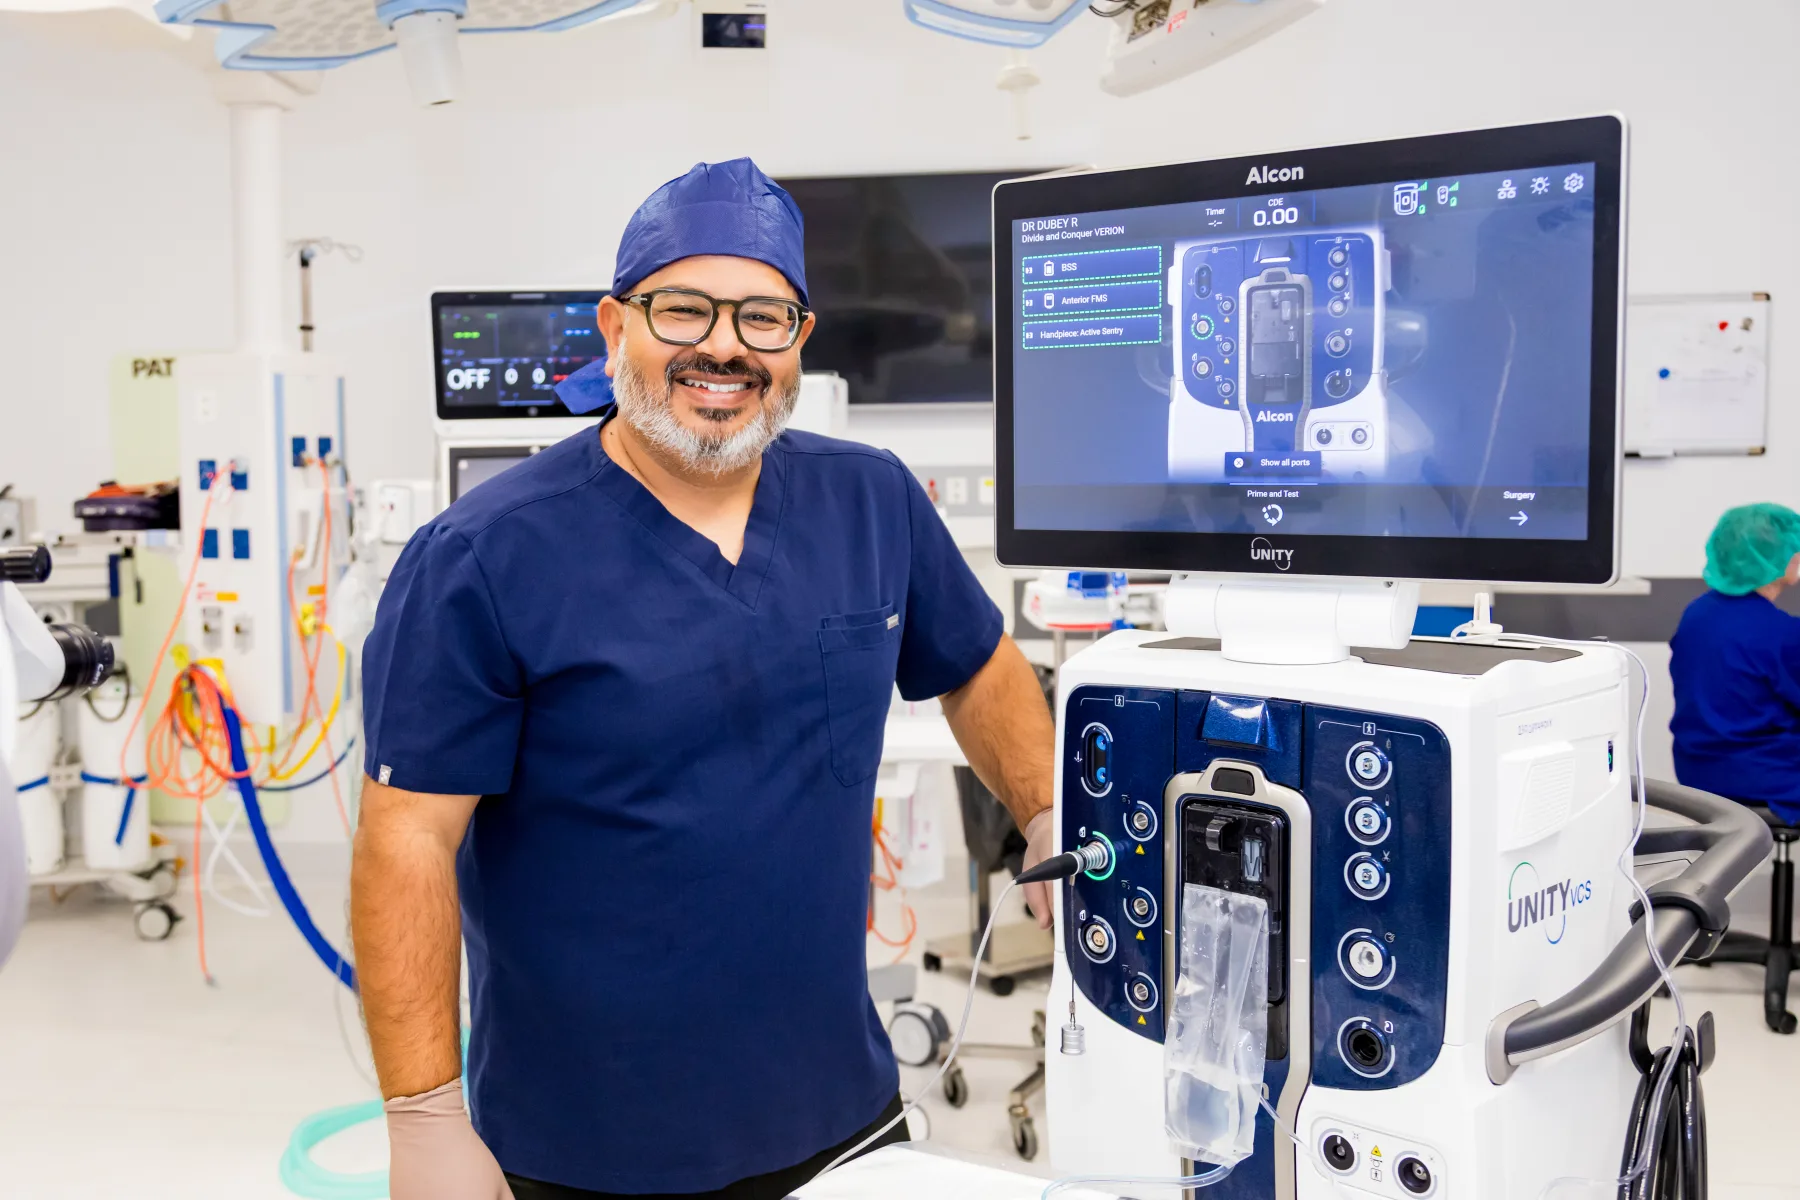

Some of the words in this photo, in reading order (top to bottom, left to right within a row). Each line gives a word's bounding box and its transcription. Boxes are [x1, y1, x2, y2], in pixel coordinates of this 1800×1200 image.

[1245, 165, 1304, 185] Alcon
[1268, 198, 1284, 207] CDE
[1205, 208, 1226, 216] Timer
[1253, 207, 1299, 226] 0.00
[1021, 222, 1035, 232] DR
[1037, 218, 1069, 231] DUBEY
[1071, 217, 1079, 228] R
[1021, 233, 1045, 243] Divide
[1046, 232, 1060, 241] and
[1061, 230, 1093, 240] Conquer
[1095, 226, 1125, 237] VERION
[1061, 263, 1077, 272] BSS
[1061, 295, 1090, 305] Anterior
[1091, 294, 1108, 303] FMS
[1040, 329, 1079, 340] Handpiece:
[1080, 328, 1101, 337] Active
[1102, 327, 1124, 337] Sentry
[447, 368, 491, 390] OFF
[1256, 410, 1294, 422] Alcon
[1260, 459, 1280, 467] Show
[1281, 458, 1290, 467] all
[1291, 459, 1311, 468] ports
[1247, 490, 1268, 498] Prime
[1269, 490, 1283, 498] and
[1283, 490, 1299, 498] Test
[1503, 490, 1536, 501] Surgery
[1250, 548, 1294, 561] UNITY
[1508, 878, 1571, 933] UNITY
[1570, 879, 1592, 907] VCS
